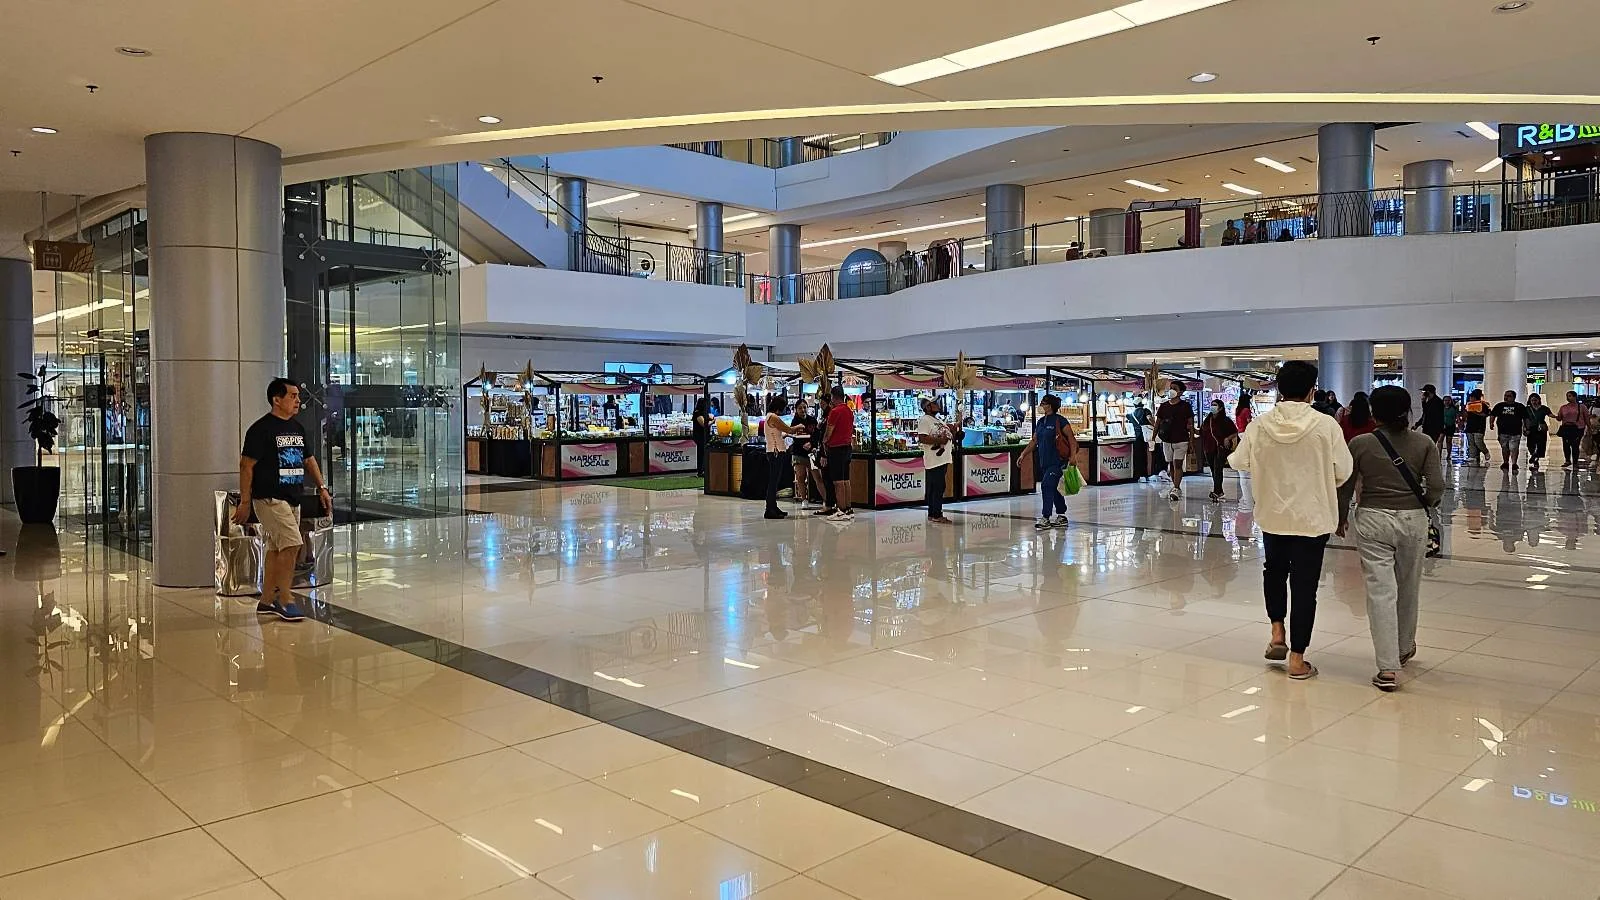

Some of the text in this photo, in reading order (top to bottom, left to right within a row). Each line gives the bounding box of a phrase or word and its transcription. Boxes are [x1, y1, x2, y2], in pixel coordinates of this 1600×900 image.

[1517, 123, 1576, 148] R&B
[569, 454, 602, 462] MARKET
[1103, 456, 1125, 464] MARKET
[1109, 462, 1130, 470] LOCALE
[971, 468, 999, 477] MARKET
[881, 473, 914, 483] MARKET
[980, 474, 1005, 483] LOCALE
[891, 480, 922, 490] LOCALE
